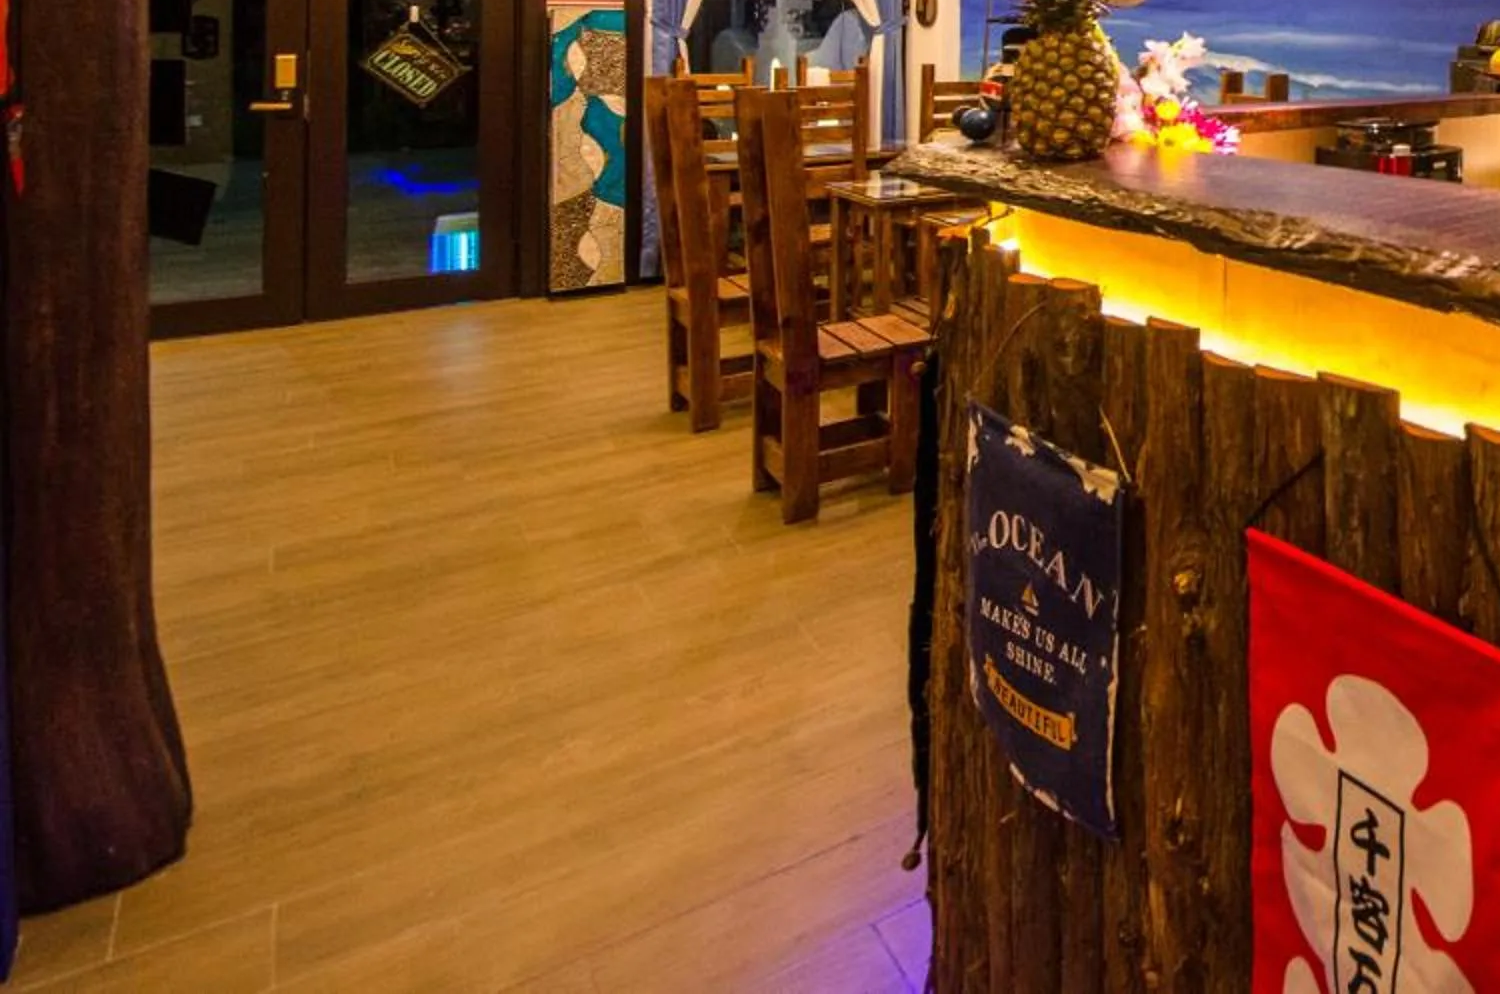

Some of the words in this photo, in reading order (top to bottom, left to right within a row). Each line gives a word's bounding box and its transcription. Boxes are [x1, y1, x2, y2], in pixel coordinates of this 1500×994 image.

[372, 49, 438, 97] CLOSED
[988, 509, 1105, 620] OCEAN
[980, 597, 1031, 639] MAKES
[1035, 626, 1055, 653] US
[1058, 642, 1087, 675] ALL
